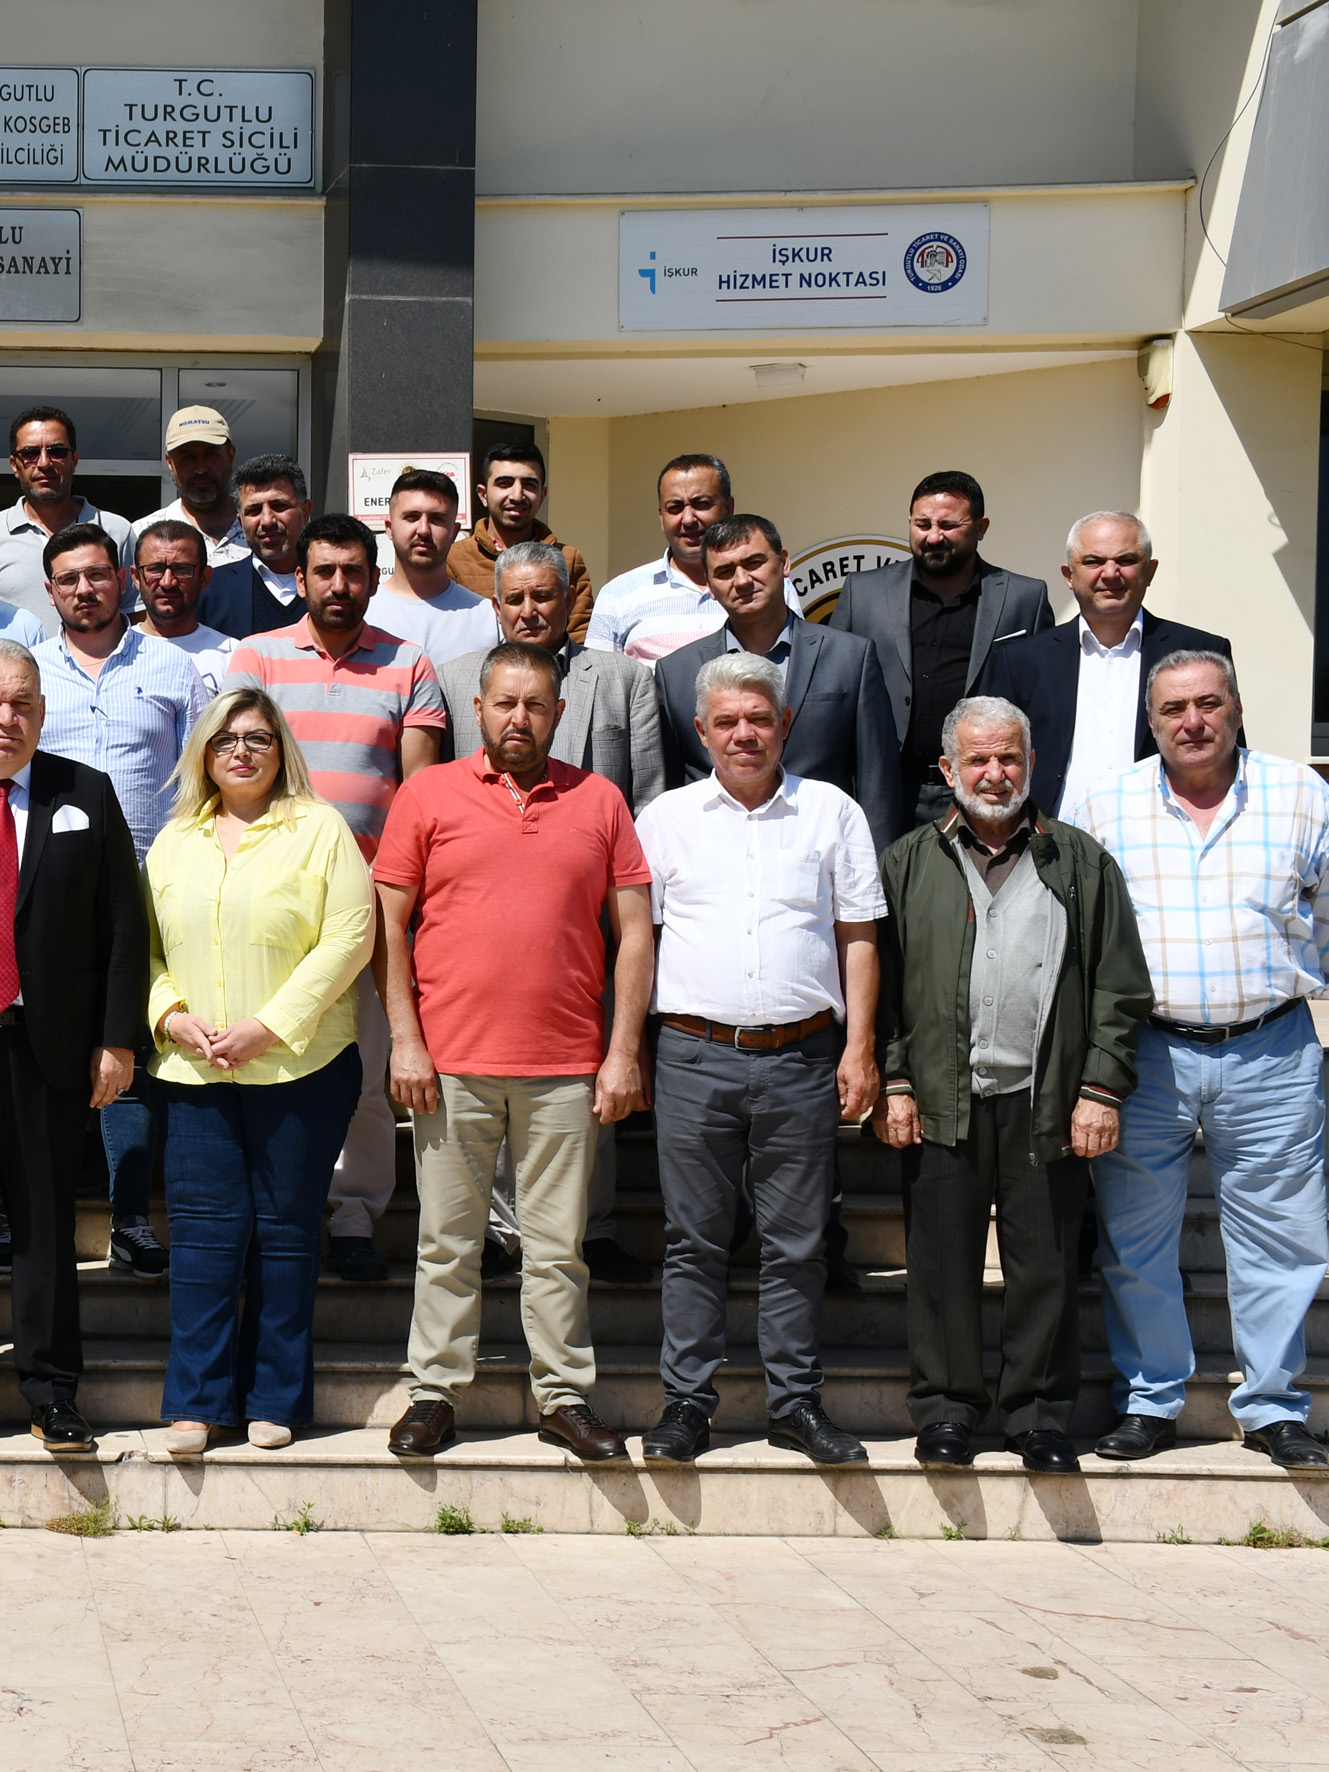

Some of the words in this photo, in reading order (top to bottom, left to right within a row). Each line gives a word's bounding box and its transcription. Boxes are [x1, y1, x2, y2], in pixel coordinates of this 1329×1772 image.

[124, 103, 273, 123] TURGUTLU
[3, 115, 71, 134] KOSGEB
[97, 124, 212, 148] TİCARET
[222, 126, 299, 150] SİCİLİ
[104, 150, 292, 175] MÜDÜRLÜĞÜ
[771, 243, 833, 267] İŞKUR
[663, 265, 698, 278] İŞKUR
[717, 270, 792, 291] HİZMET
[799, 270, 887, 290] NOKTASI
[372, 467, 391, 476] Zafer
